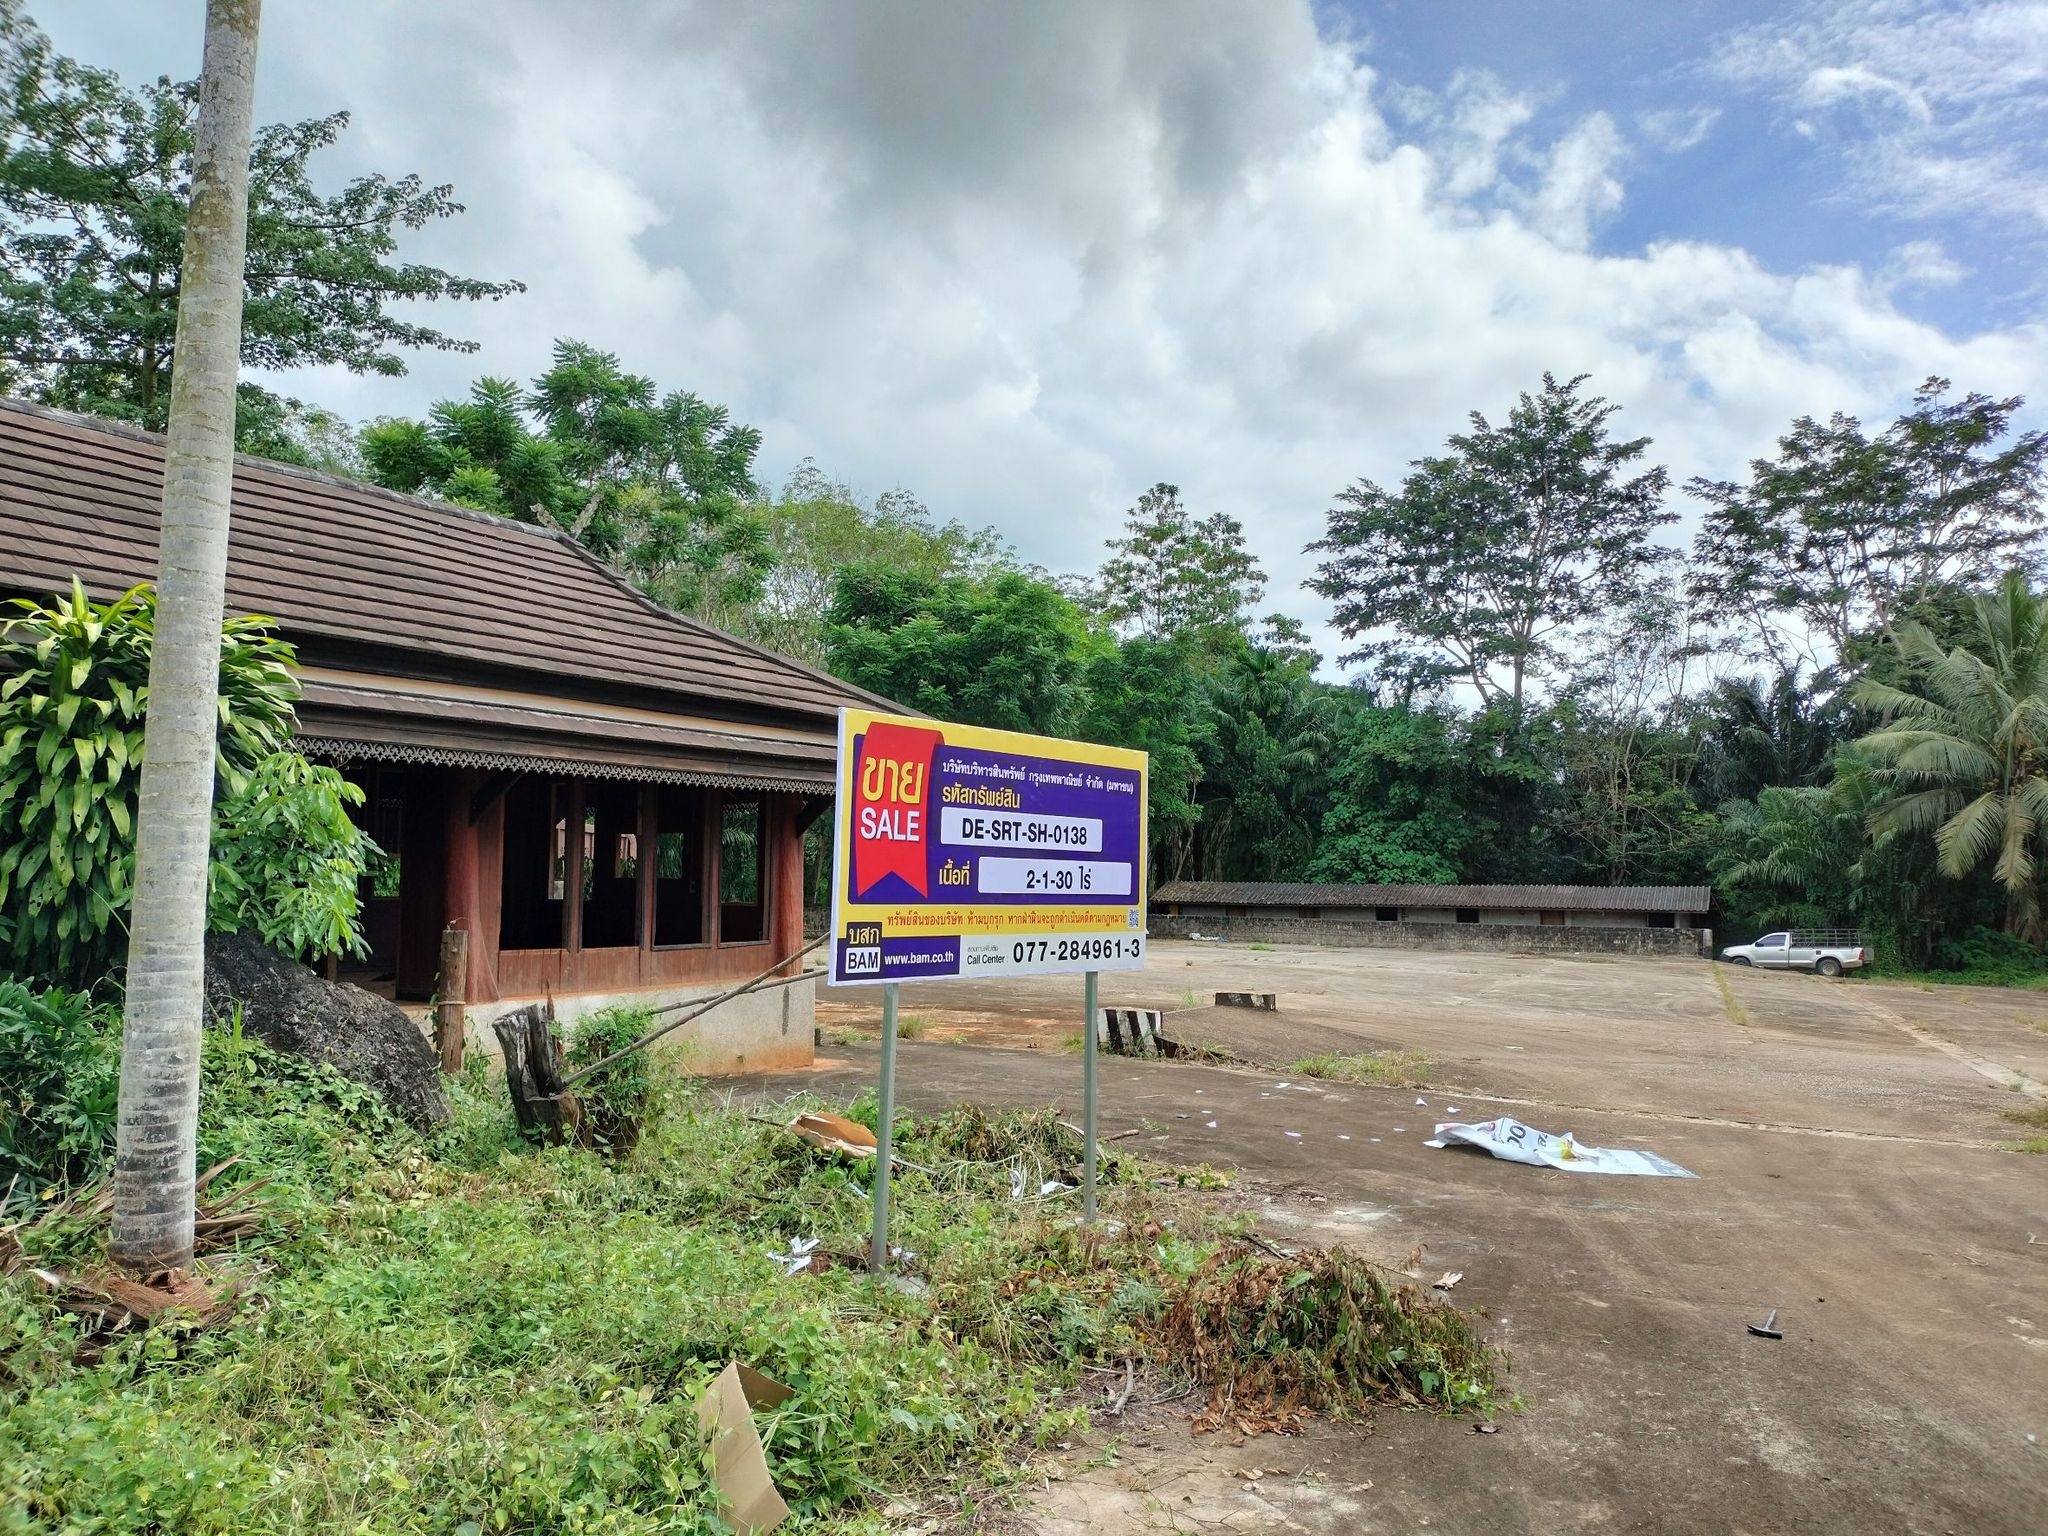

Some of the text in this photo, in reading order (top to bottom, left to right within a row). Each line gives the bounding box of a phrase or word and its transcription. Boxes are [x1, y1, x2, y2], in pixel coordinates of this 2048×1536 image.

[862, 756, 924, 804] ขาย
[942, 759, 1134, 795] บริษัทบริหารสินทรัพย์ กรุงเทพพาณิชย์ จำกัด (มหาชน)
[942, 782, 1021, 809] รหัสทรัพย์สิน
[860, 806, 920, 842] SALE
[962, 817, 1088, 846] DE-SRT-SH-0138
[938, 858, 970, 886] เนื้อที่
[1026, 866, 1092, 890] 2-1-30 ไร่
[887, 909, 964, 926] ทรัพย์สินของบริษัท
[967, 911, 1004, 930] ห้ามบุกรุก
[849, 926, 879, 945] บสก
[848, 951, 879, 970] BAM
[884, 950, 954, 966] www.bam.co.th
[967, 954, 980, 965] Call
[1013, 938, 1140, 963] 077-284961-3
